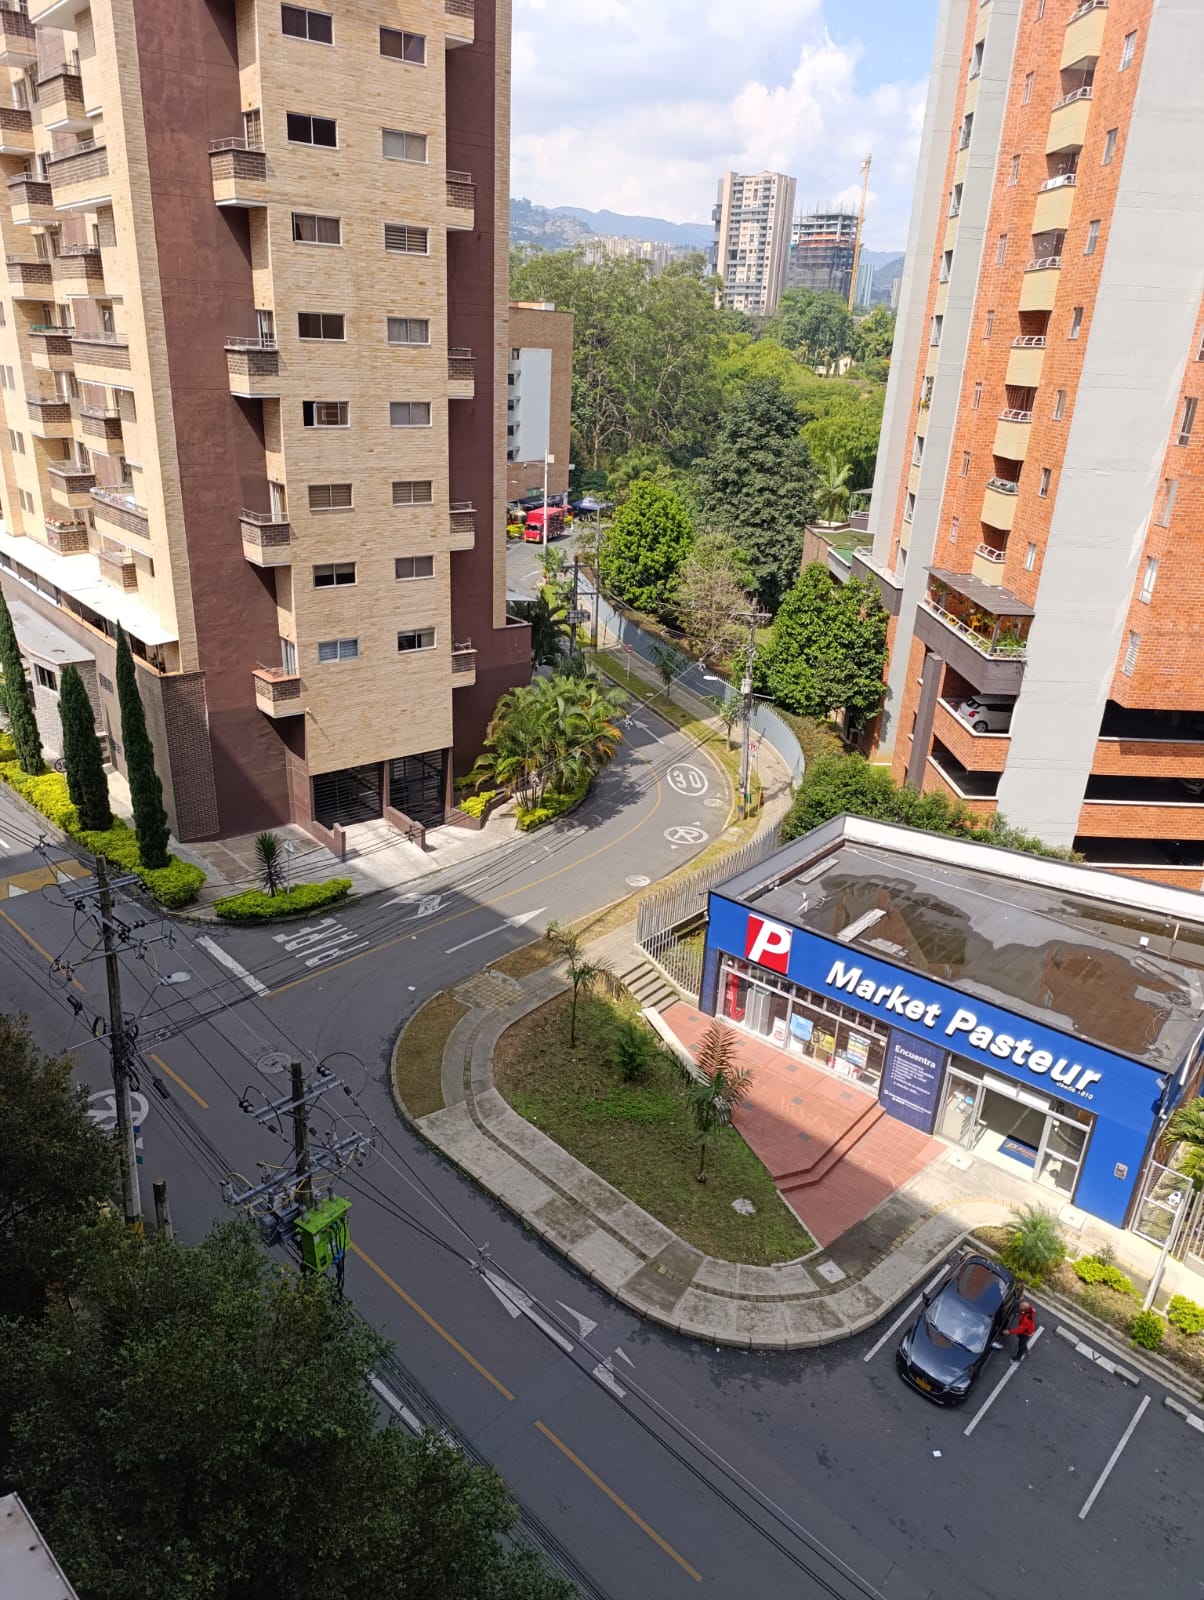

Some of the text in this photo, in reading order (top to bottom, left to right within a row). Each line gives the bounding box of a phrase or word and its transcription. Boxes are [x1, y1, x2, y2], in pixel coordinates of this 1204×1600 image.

[673, 770, 702, 789] 30
[747, 919, 792, 963] P
[825, 960, 942, 1029] Market
[944, 1008, 1102, 1091] Pasteur
[894, 1044, 936, 1069] Encuentra
